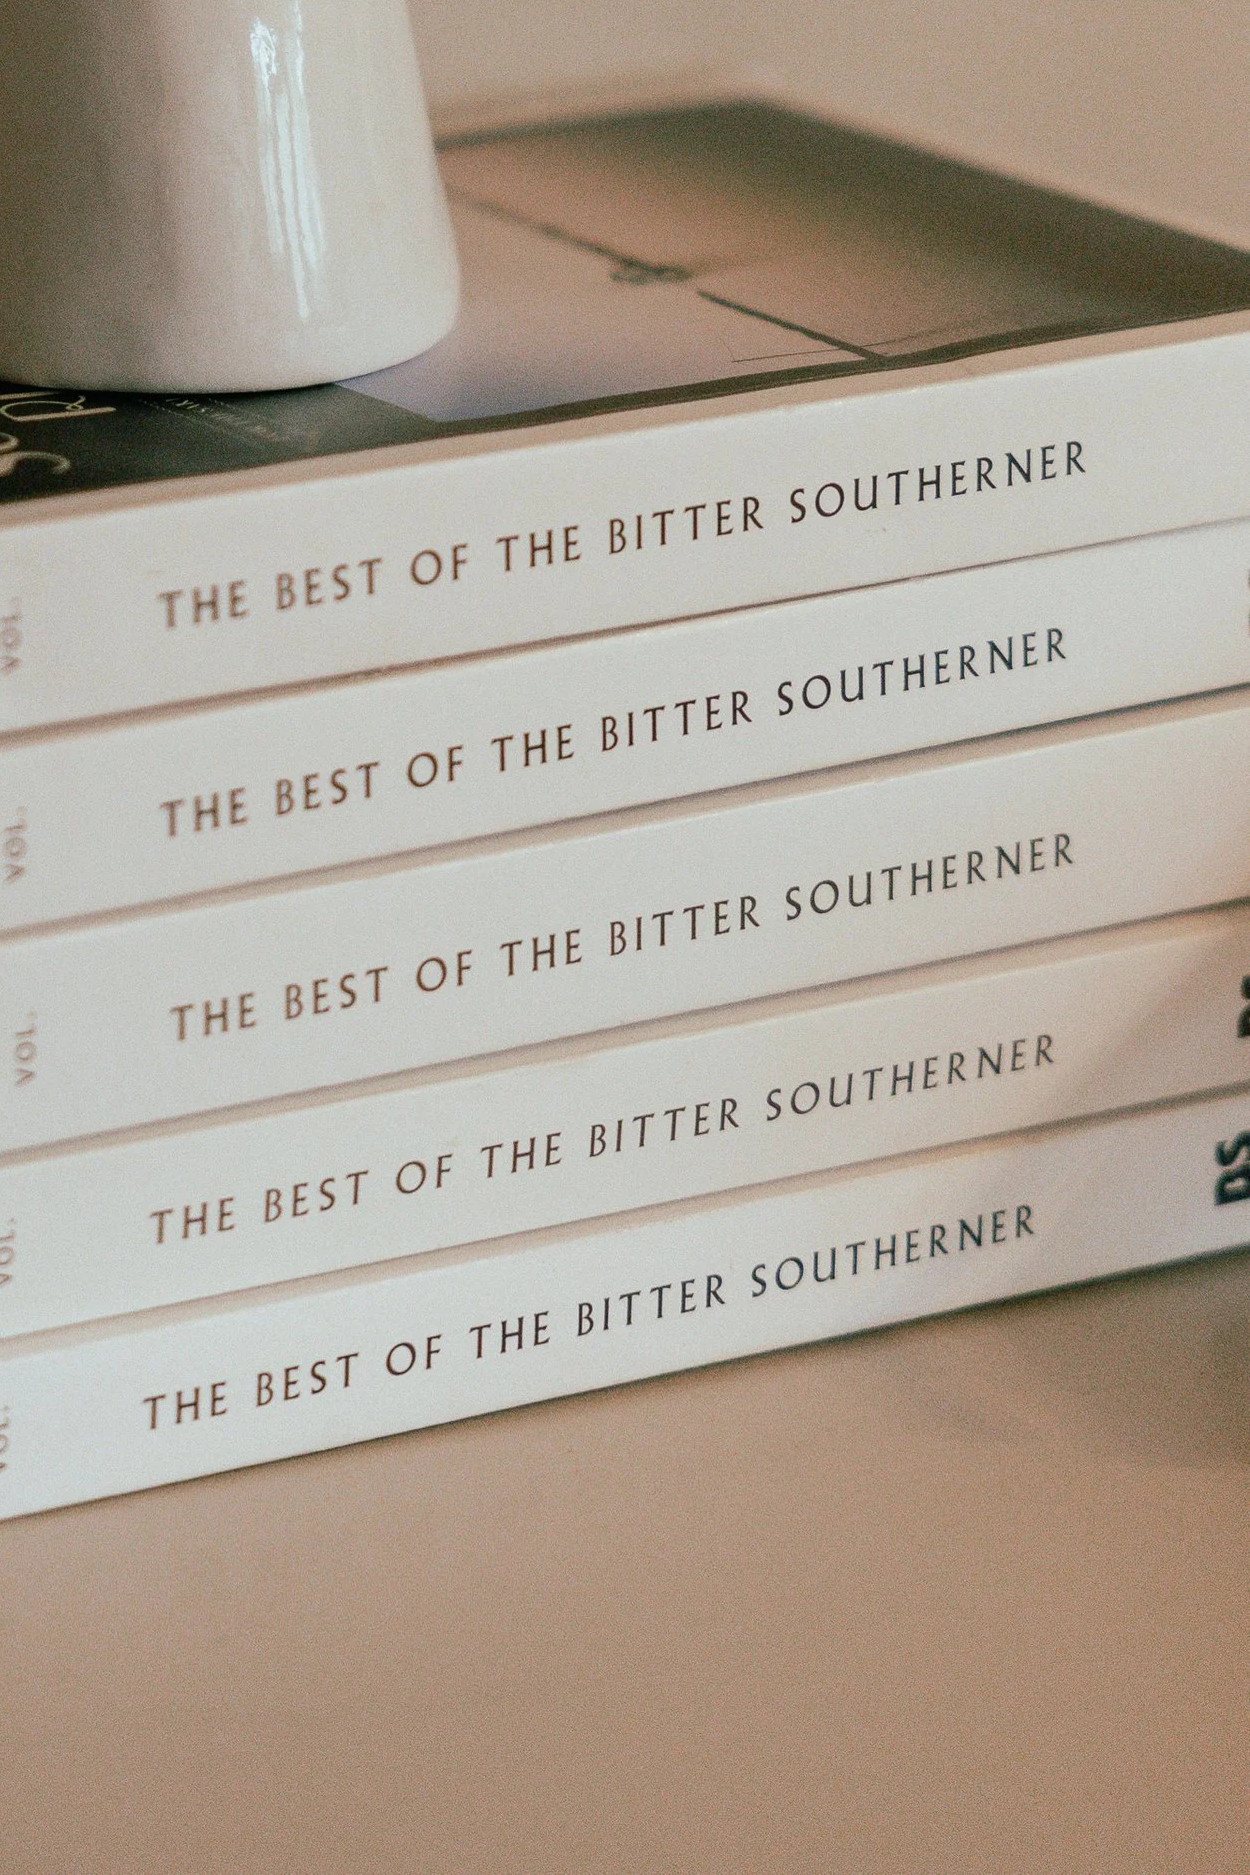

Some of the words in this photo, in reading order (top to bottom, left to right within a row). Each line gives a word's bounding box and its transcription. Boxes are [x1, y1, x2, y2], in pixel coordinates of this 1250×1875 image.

[157, 579, 248, 629] THE
[275, 556, 383, 612] BEST
[409, 542, 469, 587] OF
[495, 524, 582, 573] THE
[608, 495, 765, 556] BITTER
[789, 439, 1087, 525] SOUTHERNER
[159, 786, 248, 838] THE
[275, 760, 381, 818] BEST
[405, 744, 464, 790] OF
[490, 723, 575, 773] THE
[600, 689, 753, 753] BITTER
[776, 626, 1067, 717] SOUTHERNER
[169, 991, 257, 1042] THE
[284, 965, 390, 1021] BEST
[414, 948, 473, 994] OF
[498, 927, 583, 978] THE
[609, 894, 761, 957] BITTER
[784, 832, 1075, 922] SOUTHERNER
[148, 1196, 236, 1246] THE
[263, 1169, 370, 1224] BEST
[394, 1152, 454, 1196] OF
[479, 1131, 562, 1179] THE
[588, 1097, 740, 1159] BITTER
[765, 1033, 1055, 1123] SOUTHERNER
[141, 1380, 228, 1431] THE
[255, 1351, 360, 1408] BEST
[384, 1333, 443, 1377] OF
[468, 1309, 551, 1360] THE
[576, 1273, 726, 1338] BITTER
[750, 1203, 1035, 1299] SOUTHERNER
